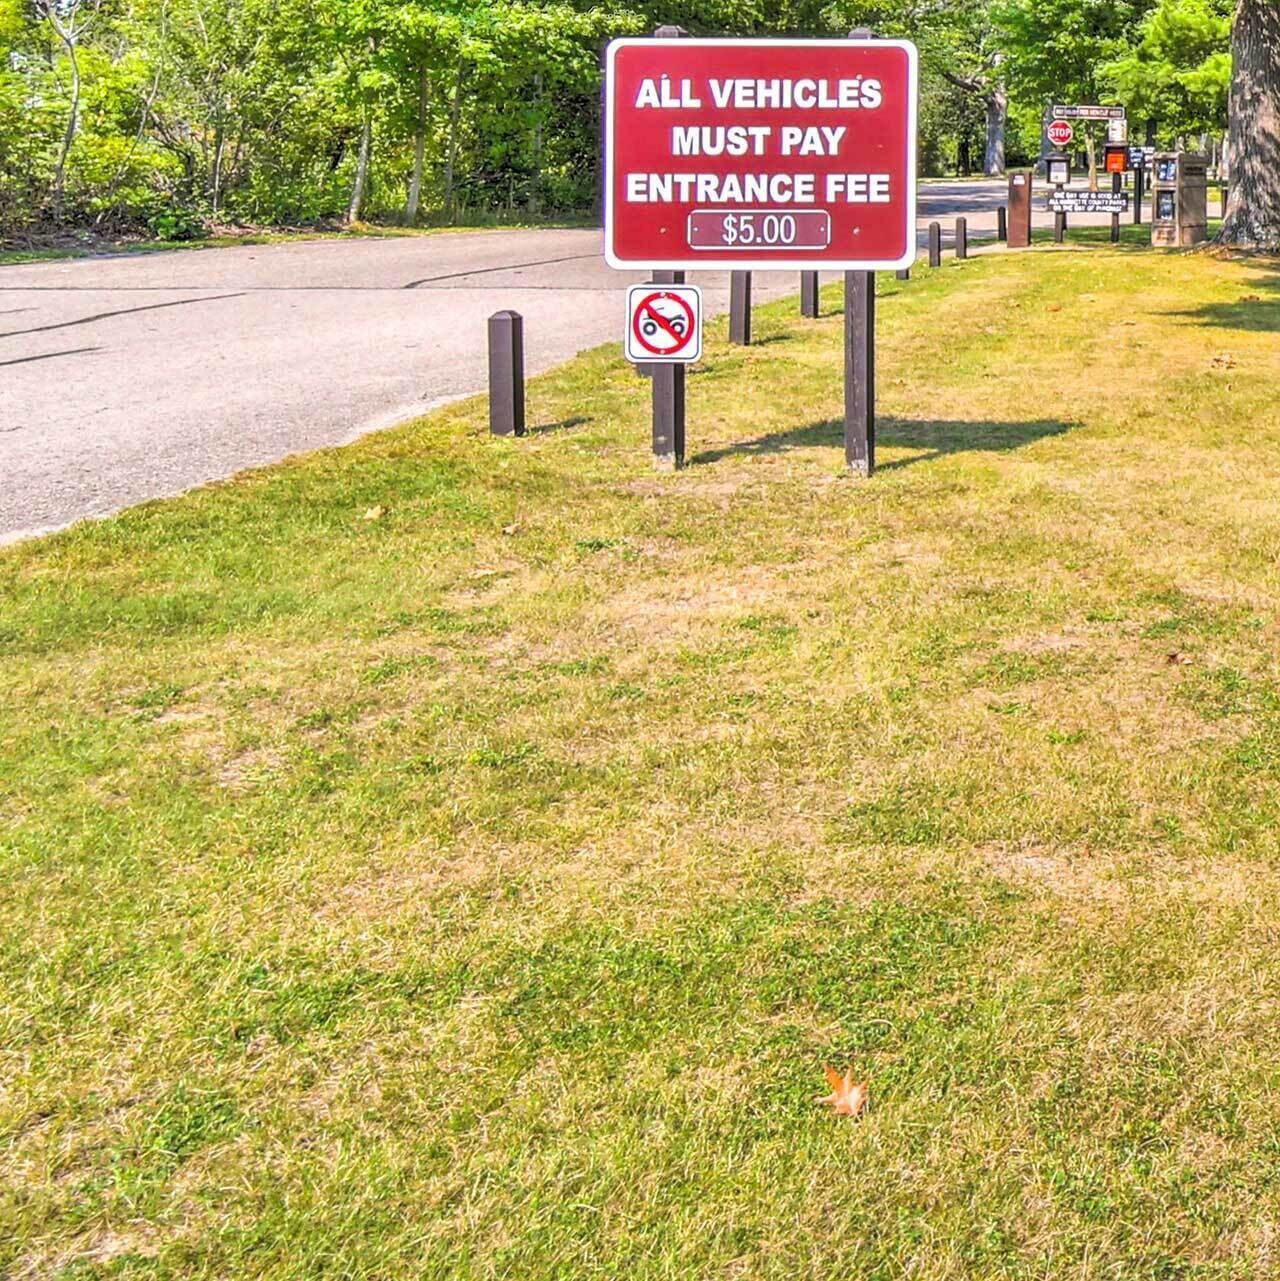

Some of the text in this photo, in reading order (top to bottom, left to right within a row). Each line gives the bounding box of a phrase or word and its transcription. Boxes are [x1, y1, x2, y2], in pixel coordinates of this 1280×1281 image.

[635, 78, 883, 109] ALL VEHICLES
[672, 126, 846, 156] MUST PAY
[1049, 127, 1071, 138] STOP
[626, 173, 890, 203] ENTRANCE FEE
[722, 213, 796, 245] $5.00
